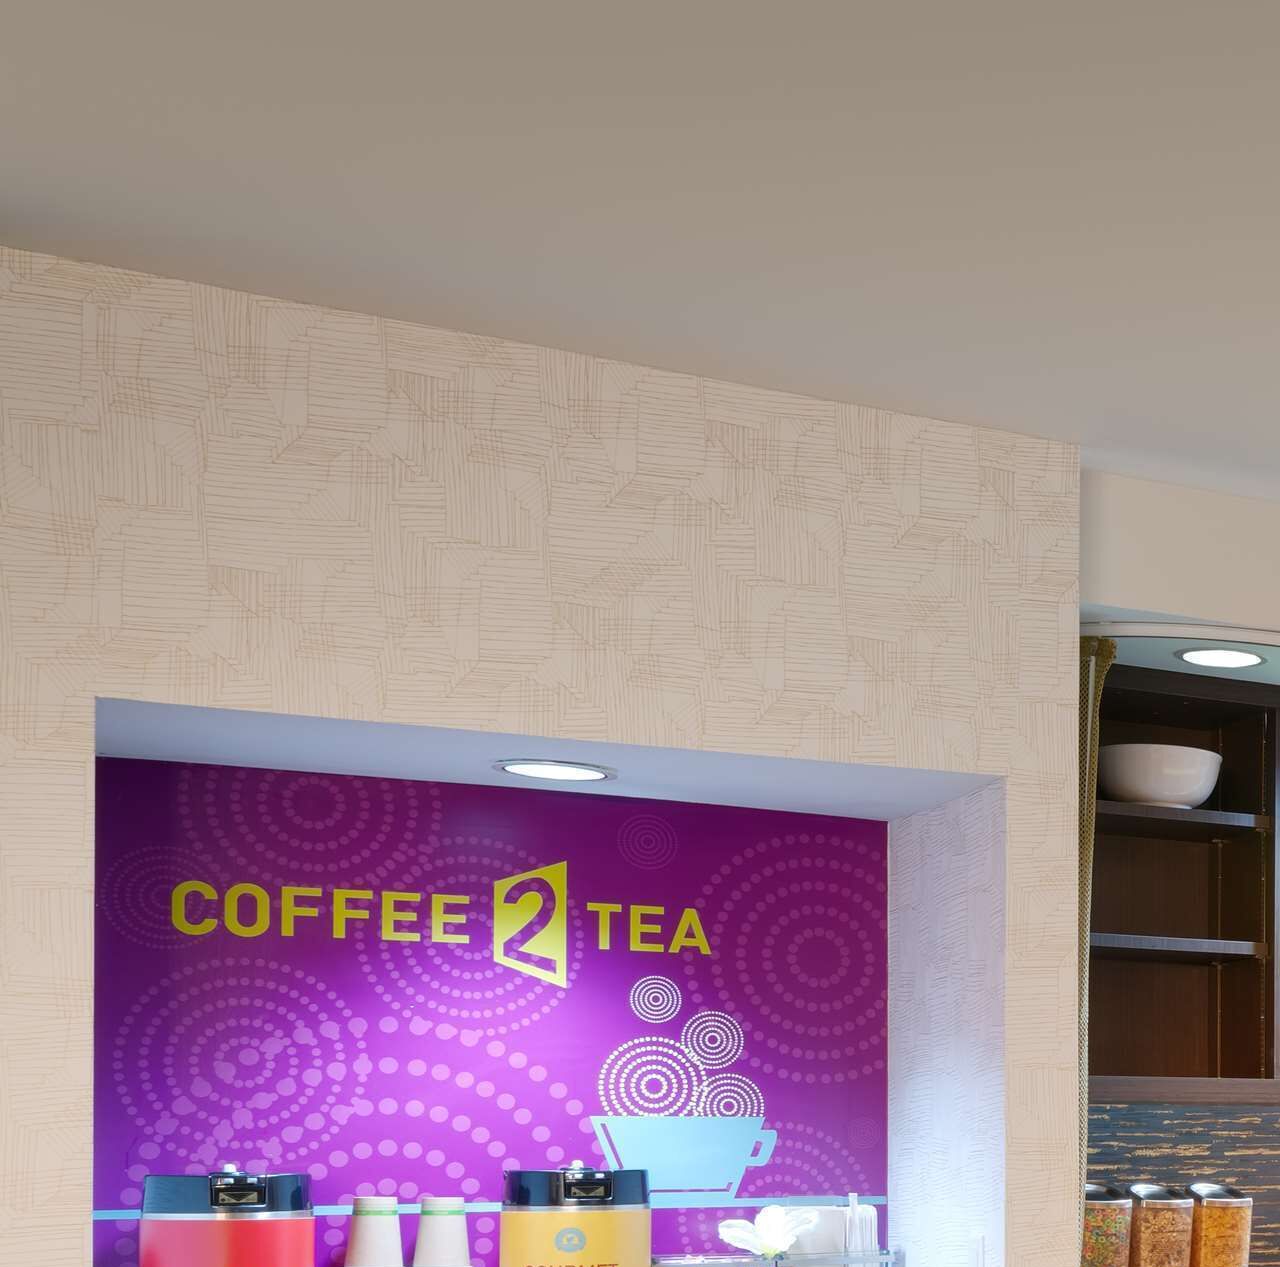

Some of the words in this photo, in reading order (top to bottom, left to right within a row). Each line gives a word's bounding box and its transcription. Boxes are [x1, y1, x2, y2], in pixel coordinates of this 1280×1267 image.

[169, 879, 471, 945] COFFEE
[500, 874, 559, 970] 2
[586, 901, 712, 956] TEA
